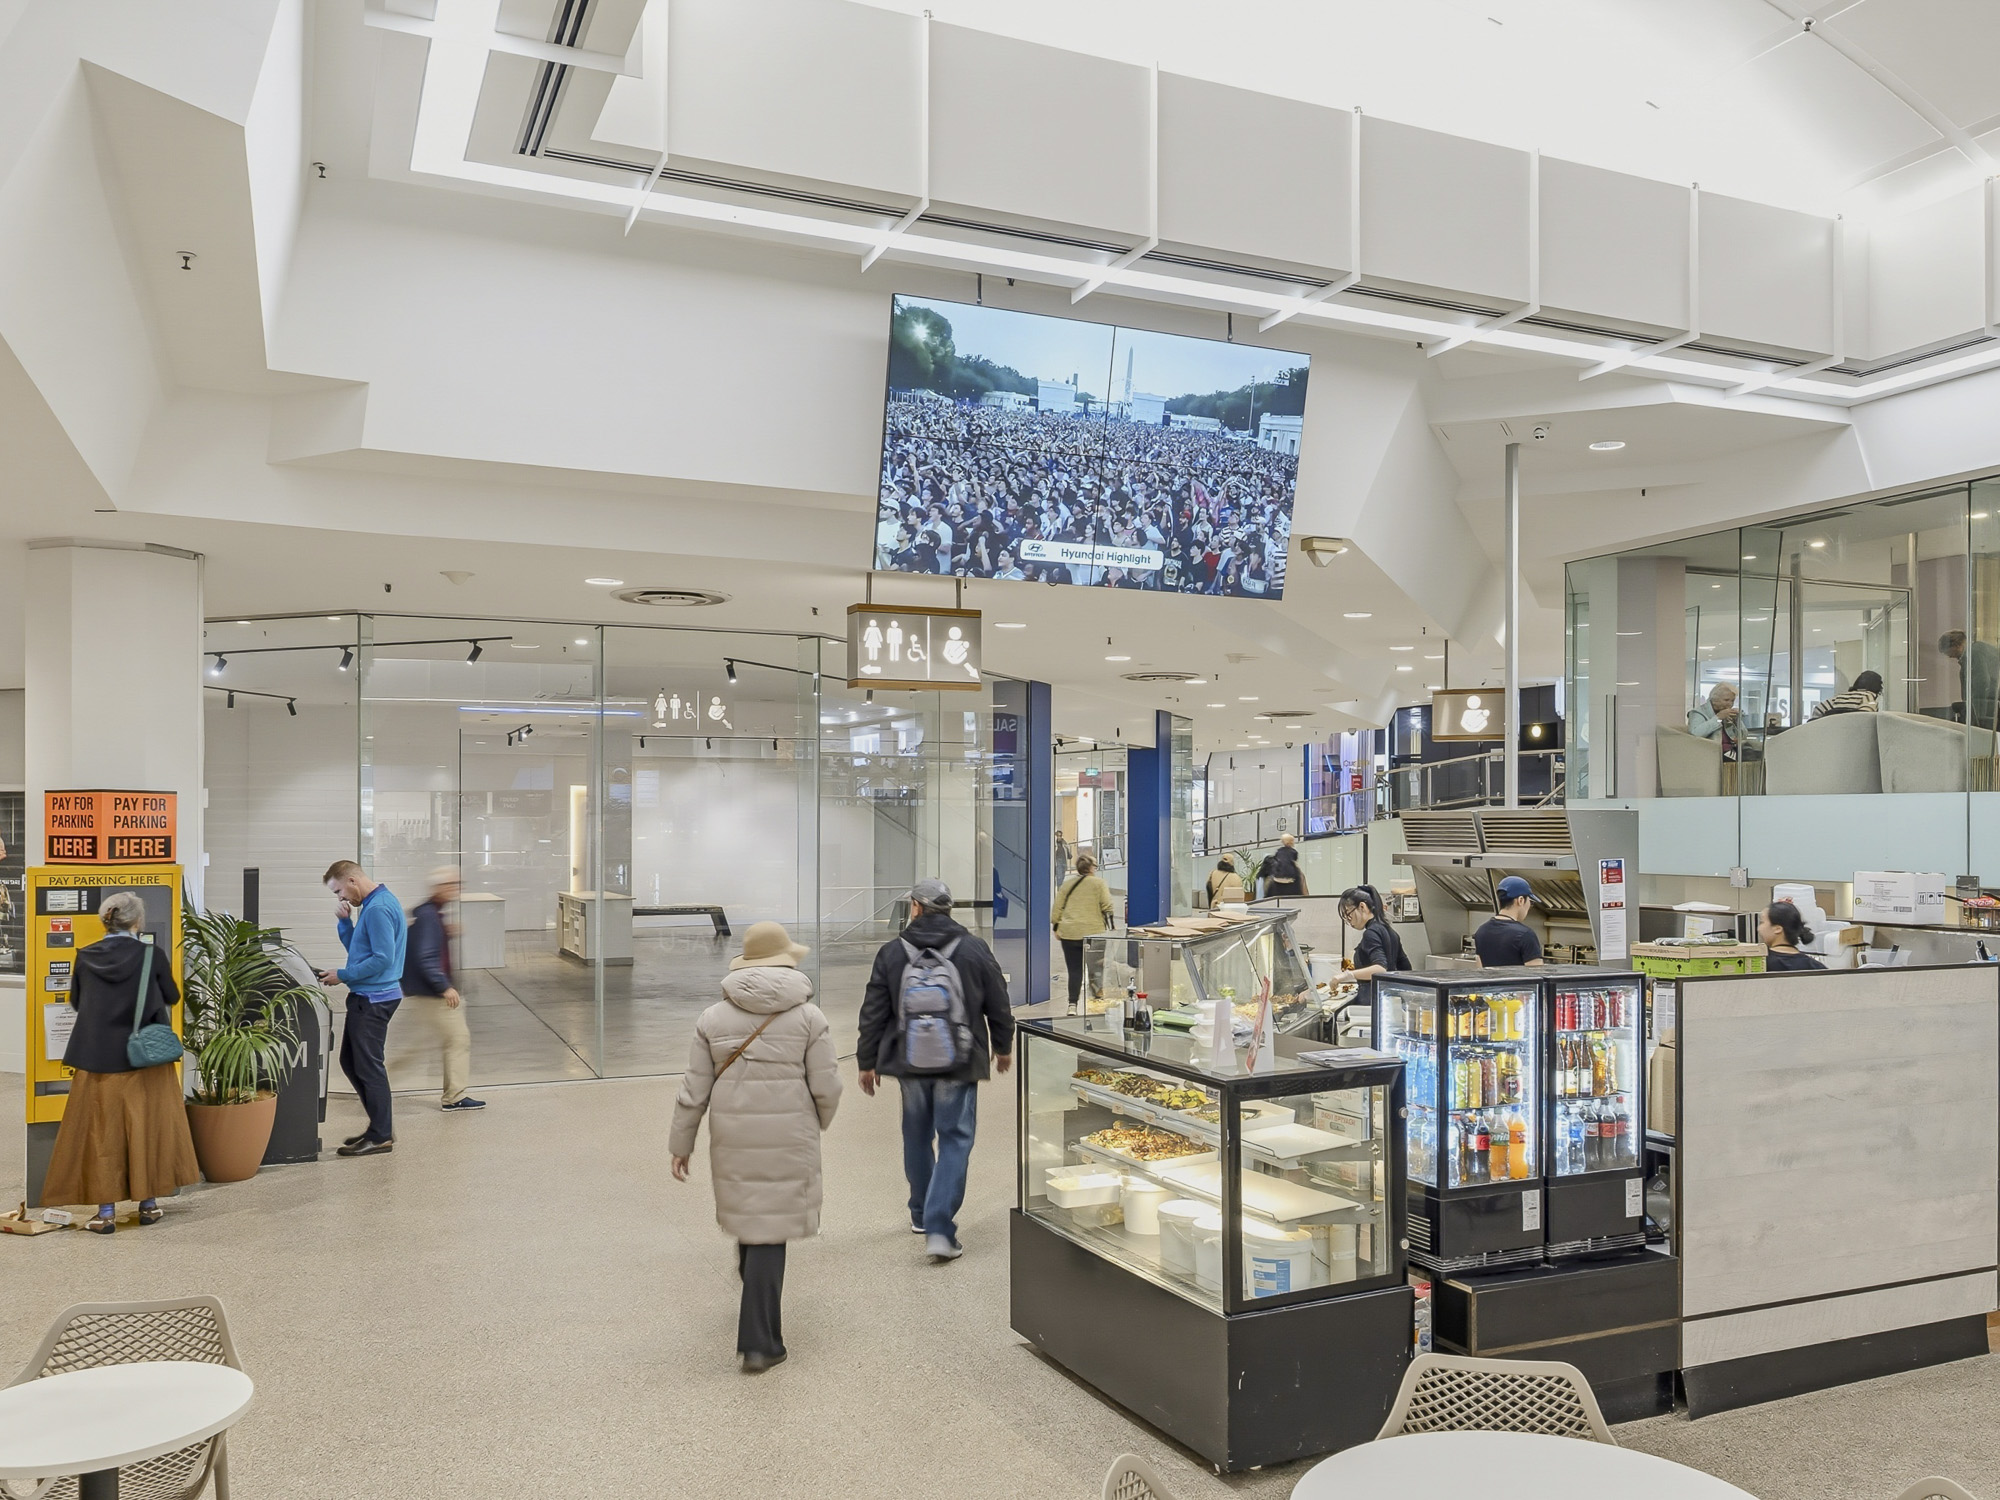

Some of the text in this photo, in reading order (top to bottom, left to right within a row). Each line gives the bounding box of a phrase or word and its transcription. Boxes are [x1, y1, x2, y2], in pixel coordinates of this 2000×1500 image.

[1061, 548, 1104, 560] Hyundai
[1106, 551, 1151, 565] Highlight
[52, 796, 94, 811] PAY FOR
[113, 797, 167, 812] PAY FOR
[51, 814, 94, 829] PARKING
[113, 815, 167, 829] PARKING
[53, 837, 93, 857] HERE
[115, 838, 165, 857] HERE
[48, 875, 160, 886] PAY PARKING HERE
